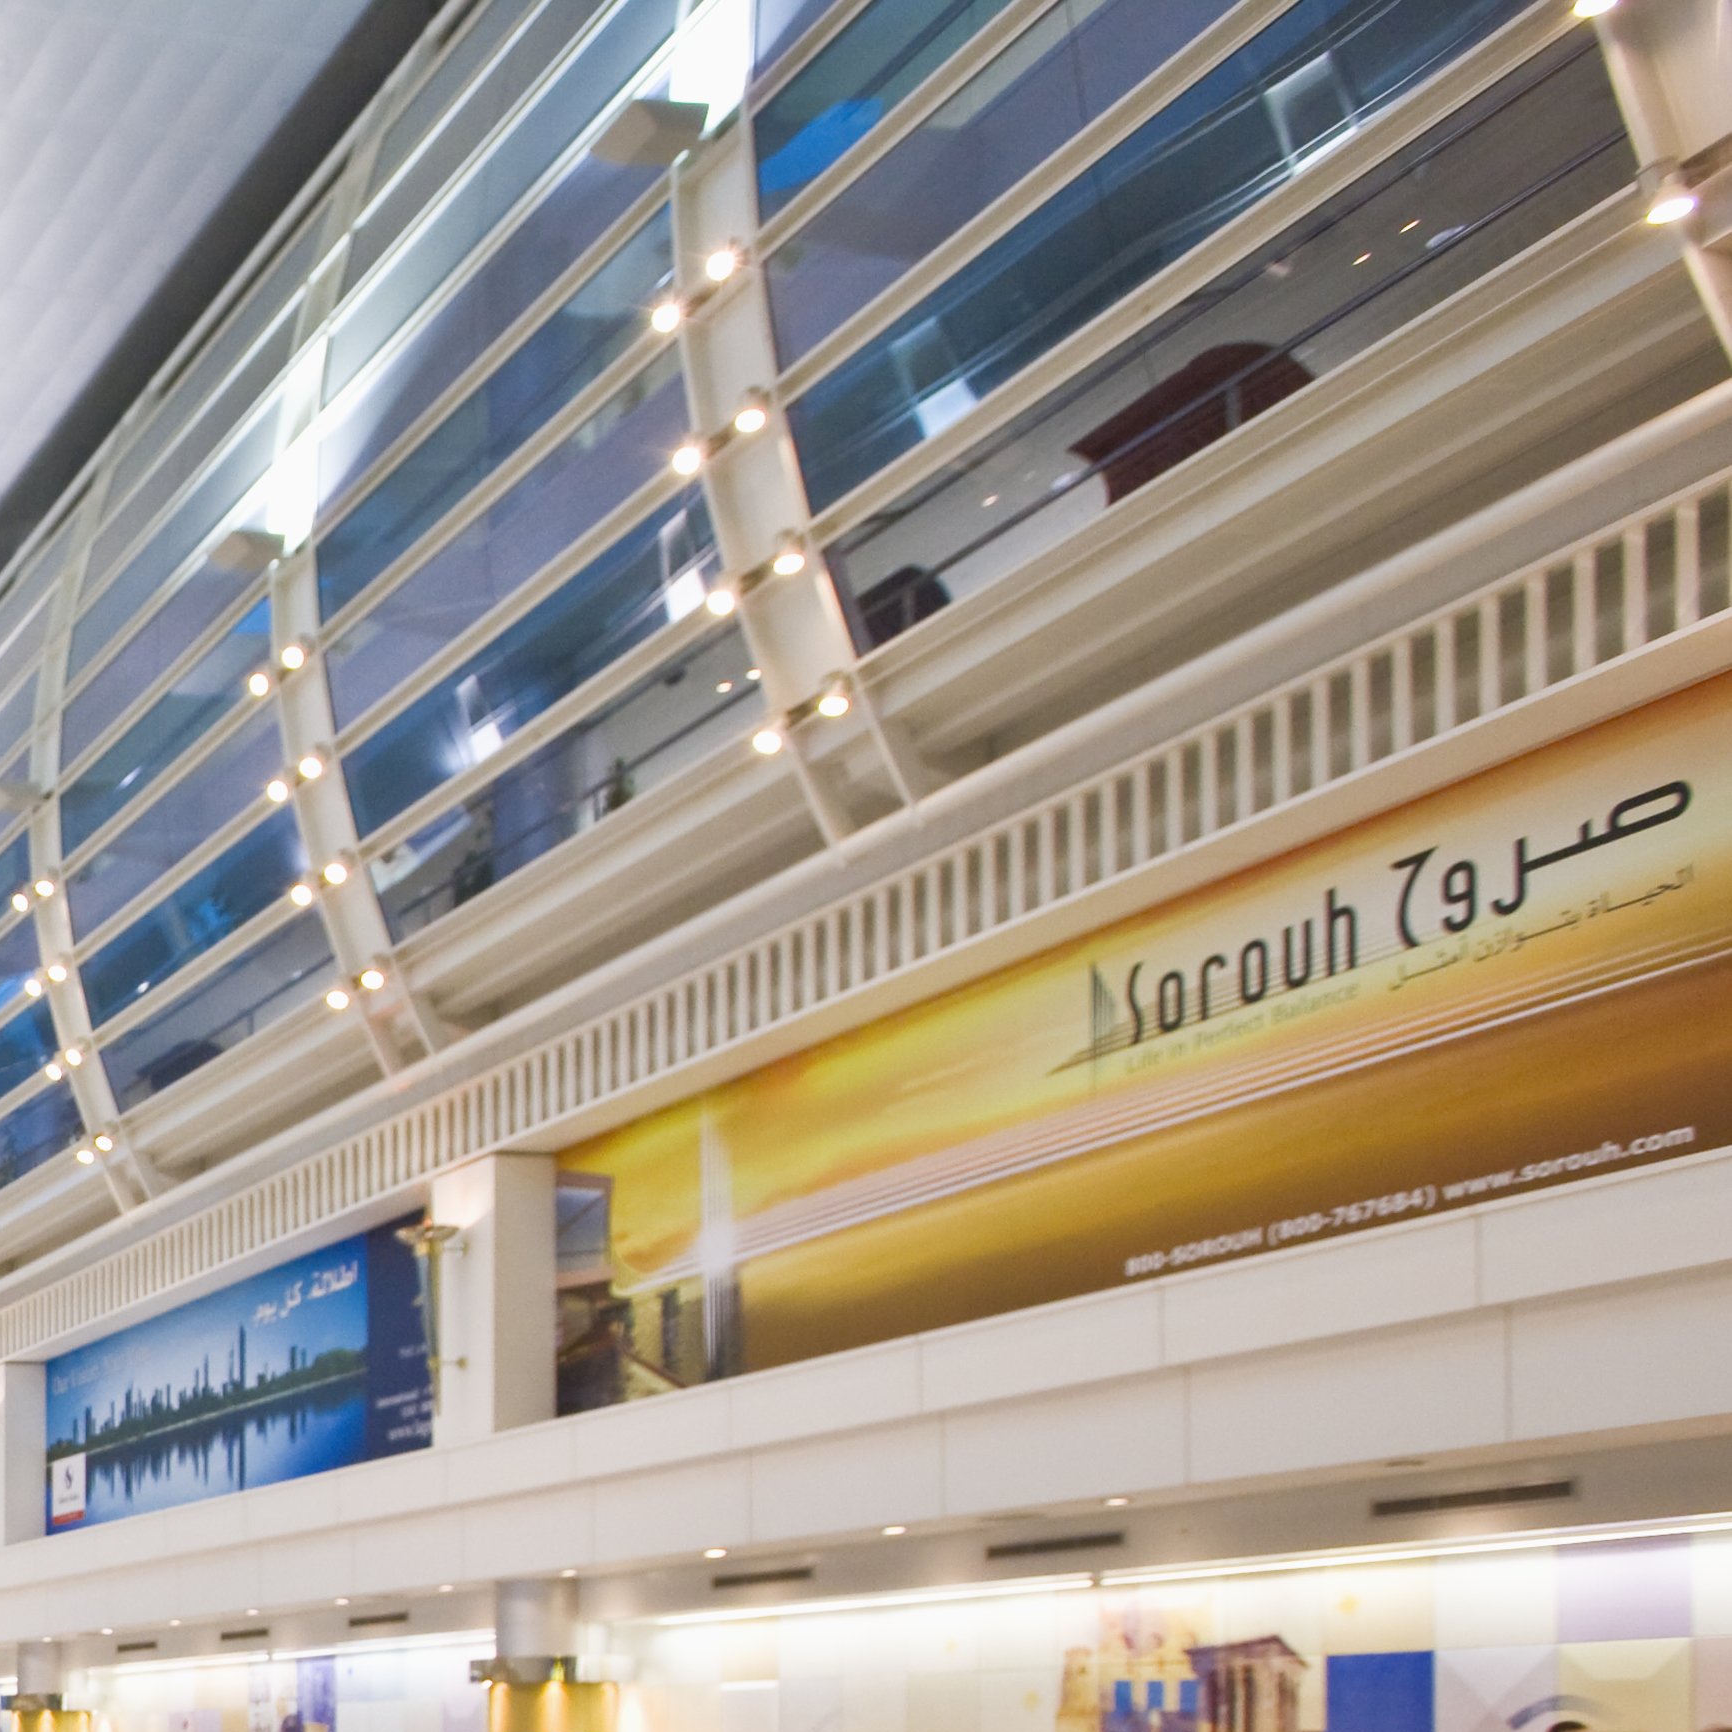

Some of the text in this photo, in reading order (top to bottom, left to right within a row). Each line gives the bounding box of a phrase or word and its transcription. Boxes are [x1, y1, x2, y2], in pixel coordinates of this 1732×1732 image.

[1389, 779, 1694, 949] صروح
[1127, 886, 1358, 1045] Sorouh
[1442, 1125, 1696, 1201] www.sorouh.com
